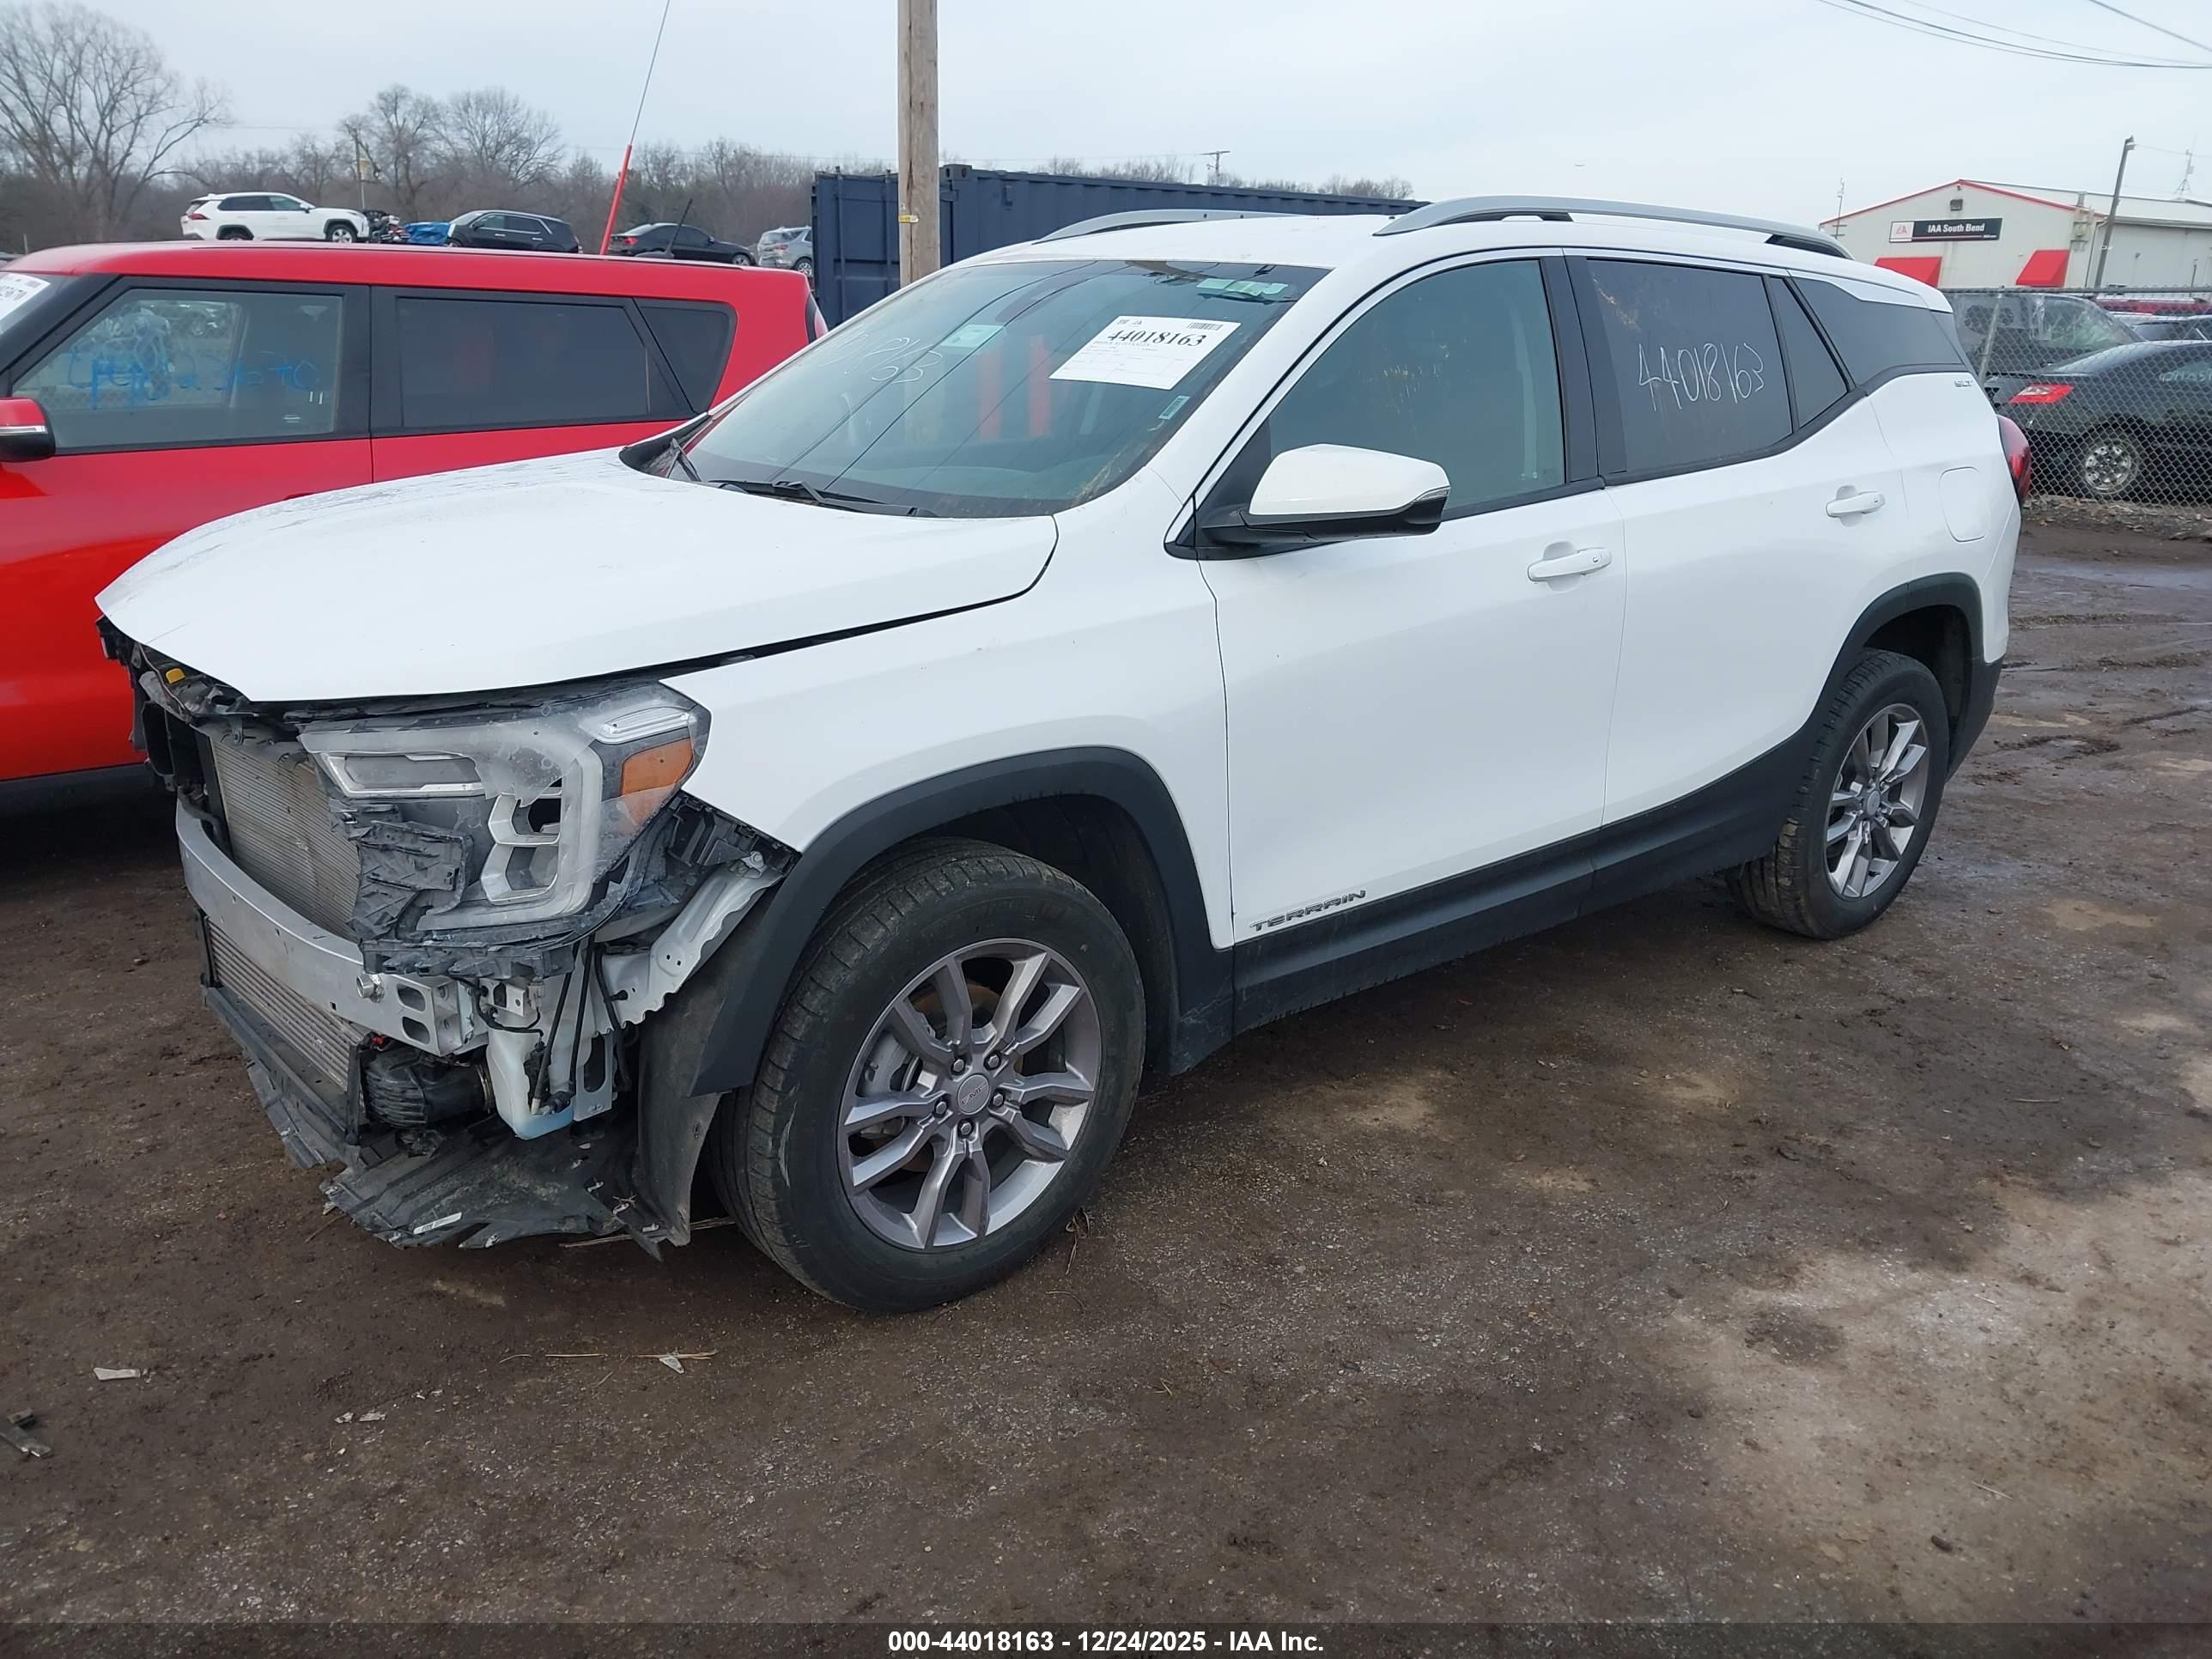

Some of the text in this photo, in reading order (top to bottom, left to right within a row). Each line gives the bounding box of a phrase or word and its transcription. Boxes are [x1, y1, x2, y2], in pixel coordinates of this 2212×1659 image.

[1928, 223, 1985, 233] IAA South Bend
[1108, 330, 1207, 347] 44018163
[1638, 343, 1765, 411] 44018163
[1249, 890, 1366, 932] TERRAIN
